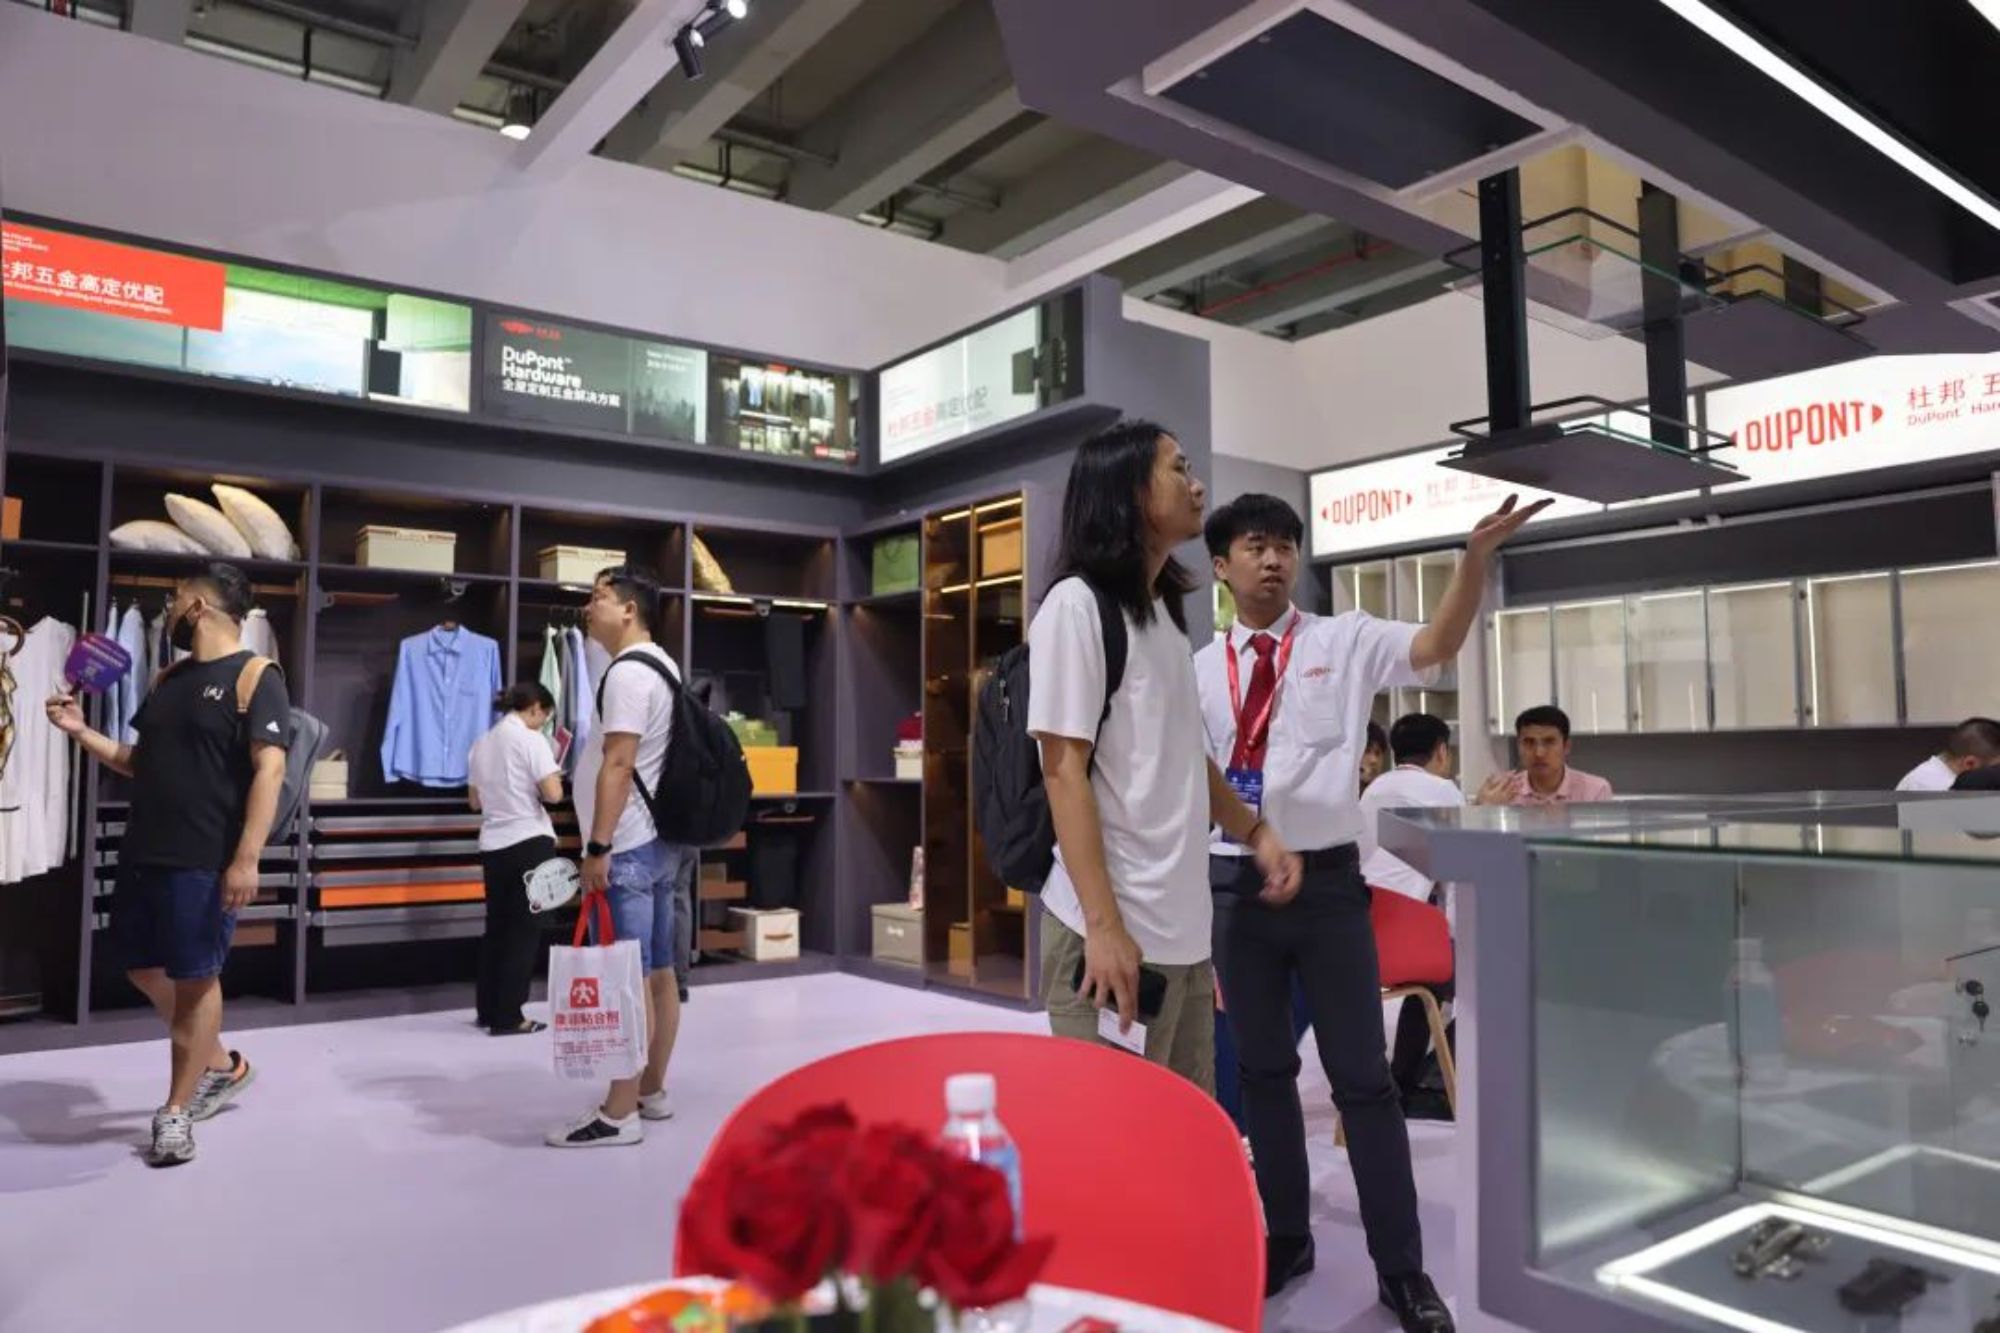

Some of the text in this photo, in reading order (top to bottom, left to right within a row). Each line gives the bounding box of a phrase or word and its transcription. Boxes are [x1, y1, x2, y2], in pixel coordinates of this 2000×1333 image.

[502, 361, 582, 388] Hardware
[1746, 401, 1864, 451] DUPONT
[1332, 490, 1402, 525] DUPONT
